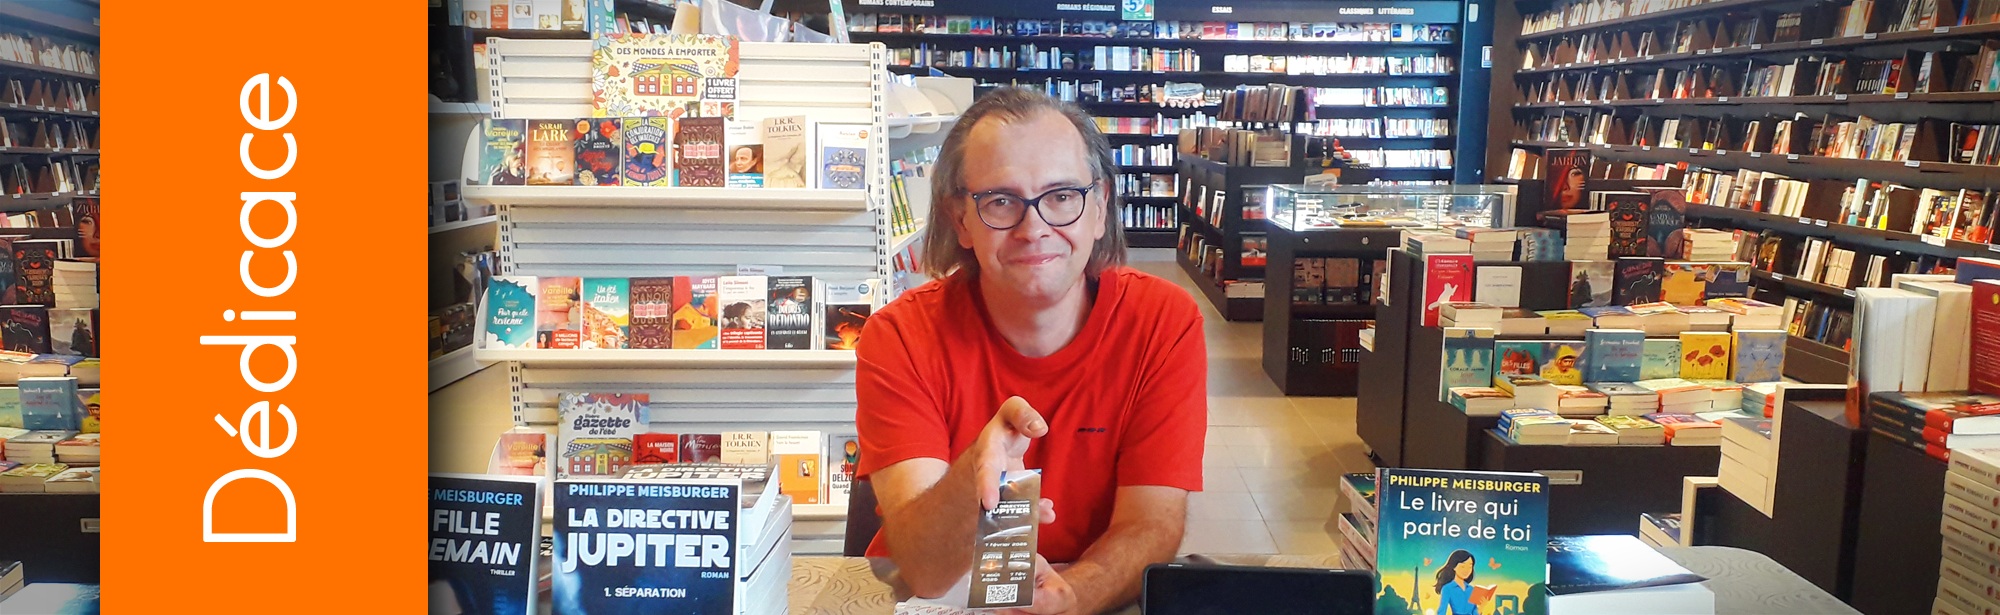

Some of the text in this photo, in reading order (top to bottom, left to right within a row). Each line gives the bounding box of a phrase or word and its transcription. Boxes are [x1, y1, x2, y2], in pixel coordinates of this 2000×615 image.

[1082, 3, 1116, 12] RÉGIONAUX
[1211, 6, 1233, 14] ESSAIS
[1378, 7, 1414, 15] LITTÉRAIRES
[617, 46, 717, 56] DES MONDES À EMPORTER
[713, 79, 735, 87] LIVRE
[641, 118, 648, 126] LA
[767, 124, 802, 133] TOLKIEN
[533, 129, 569, 142] LARK
[1552, 156, 1587, 166] JARDIN
[769, 313, 810, 327] REDONDO
[573, 415, 631, 431] gazette
[725, 440, 762, 448] TOLKIEN
[1390, 474, 1541, 493] PHILIPPE MEISBURGER
[569, 484, 729, 498] PHILIPPE MEISBURGER
[434, 489, 523, 506] MEISBURGER
[1400, 491, 1518, 520] Le livre qui
[433, 509, 500, 535] FILLE
[568, 507, 730, 529] LA DIRECTIVE
[1403, 517, 1531, 542] parle de toi
[1505, 543, 1529, 551] Roman
[562, 532, 730, 574] JUPITER
[490, 568, 515, 576] THRILLER
[701, 571, 729, 579] ROMAN
[604, 585, 686, 598] 1. SÉPARATION
